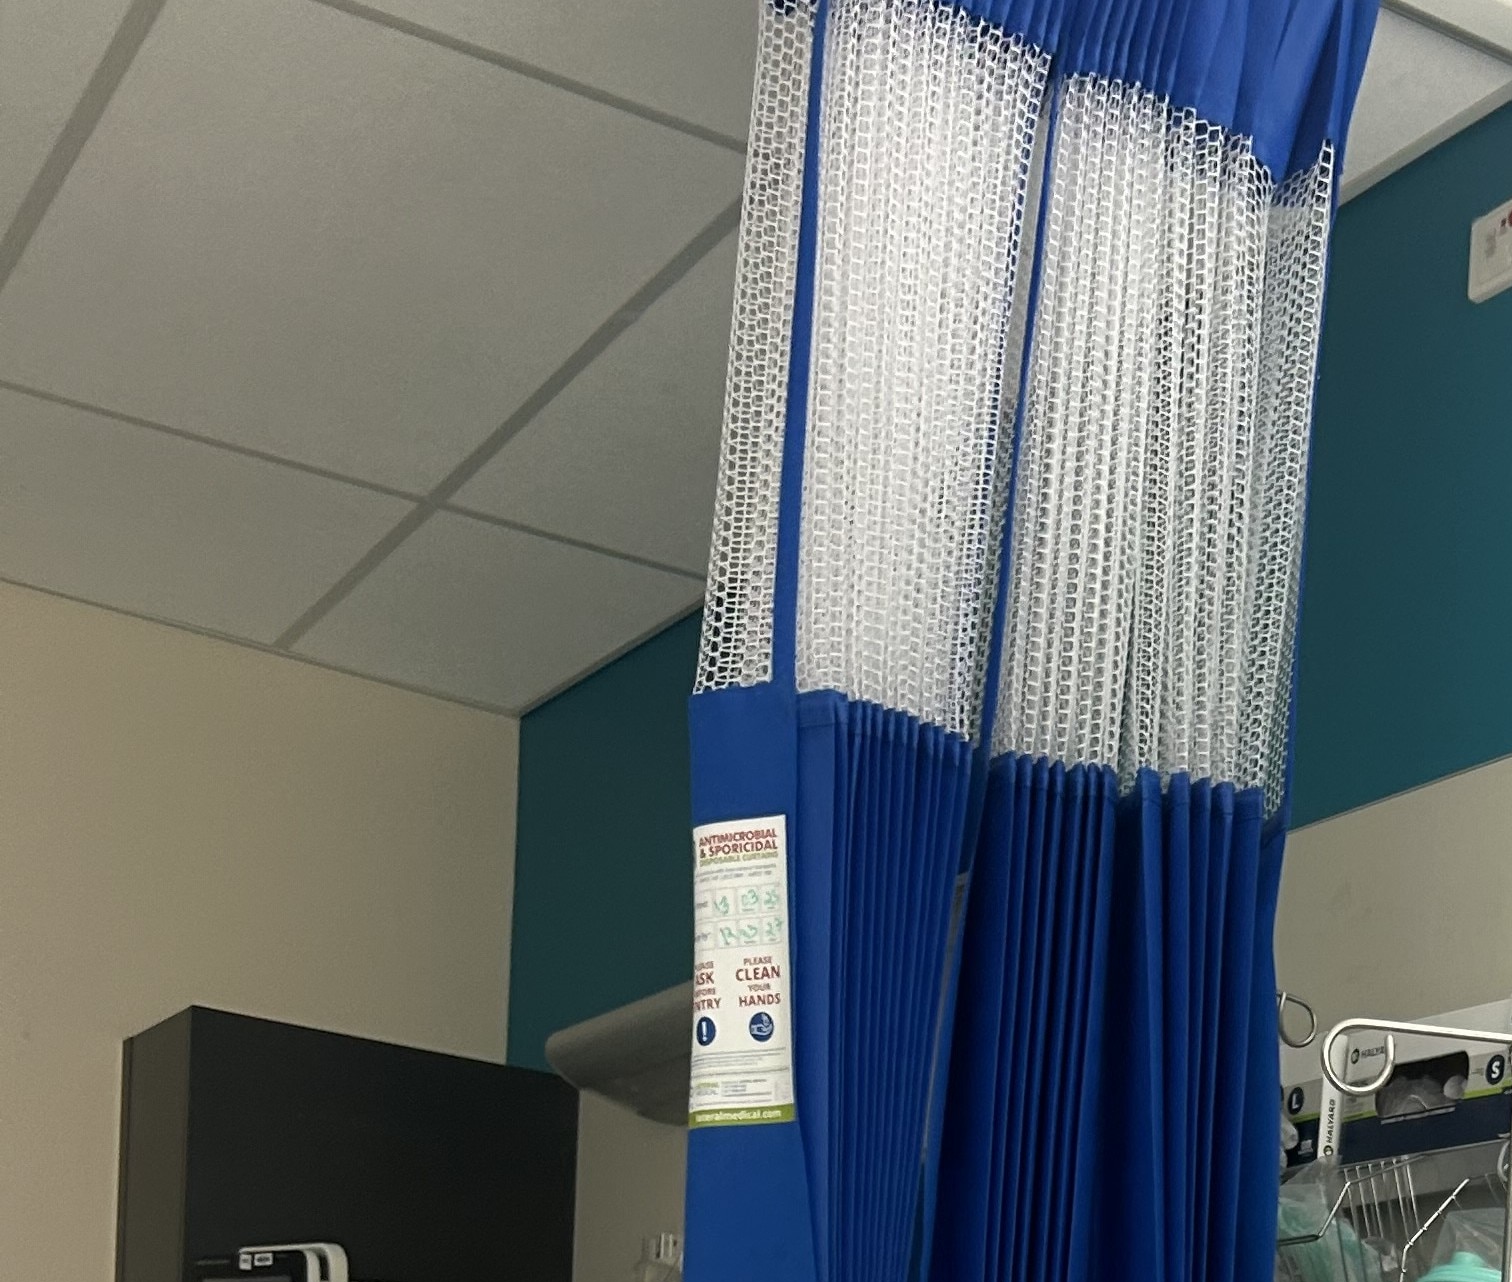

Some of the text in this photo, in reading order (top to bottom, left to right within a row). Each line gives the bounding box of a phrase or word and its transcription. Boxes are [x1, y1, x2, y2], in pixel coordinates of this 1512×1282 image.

[699, 828, 778, 847] ANTIMICROBIAL
[709, 840, 778, 857] SPORICIDAL
[743, 955, 772, 966] PLEASE
[735, 965, 781, 982] CLEAN
[693, 997, 722, 1013] NTRY
[738, 992, 782, 1008] HANDS
[1360, 1045, 1386, 1059] HALYA
[1491, 1060, 1501, 1079] S
[1291, 1093, 1300, 1104] L
[1328, 1098, 1336, 1144] HALYARD
